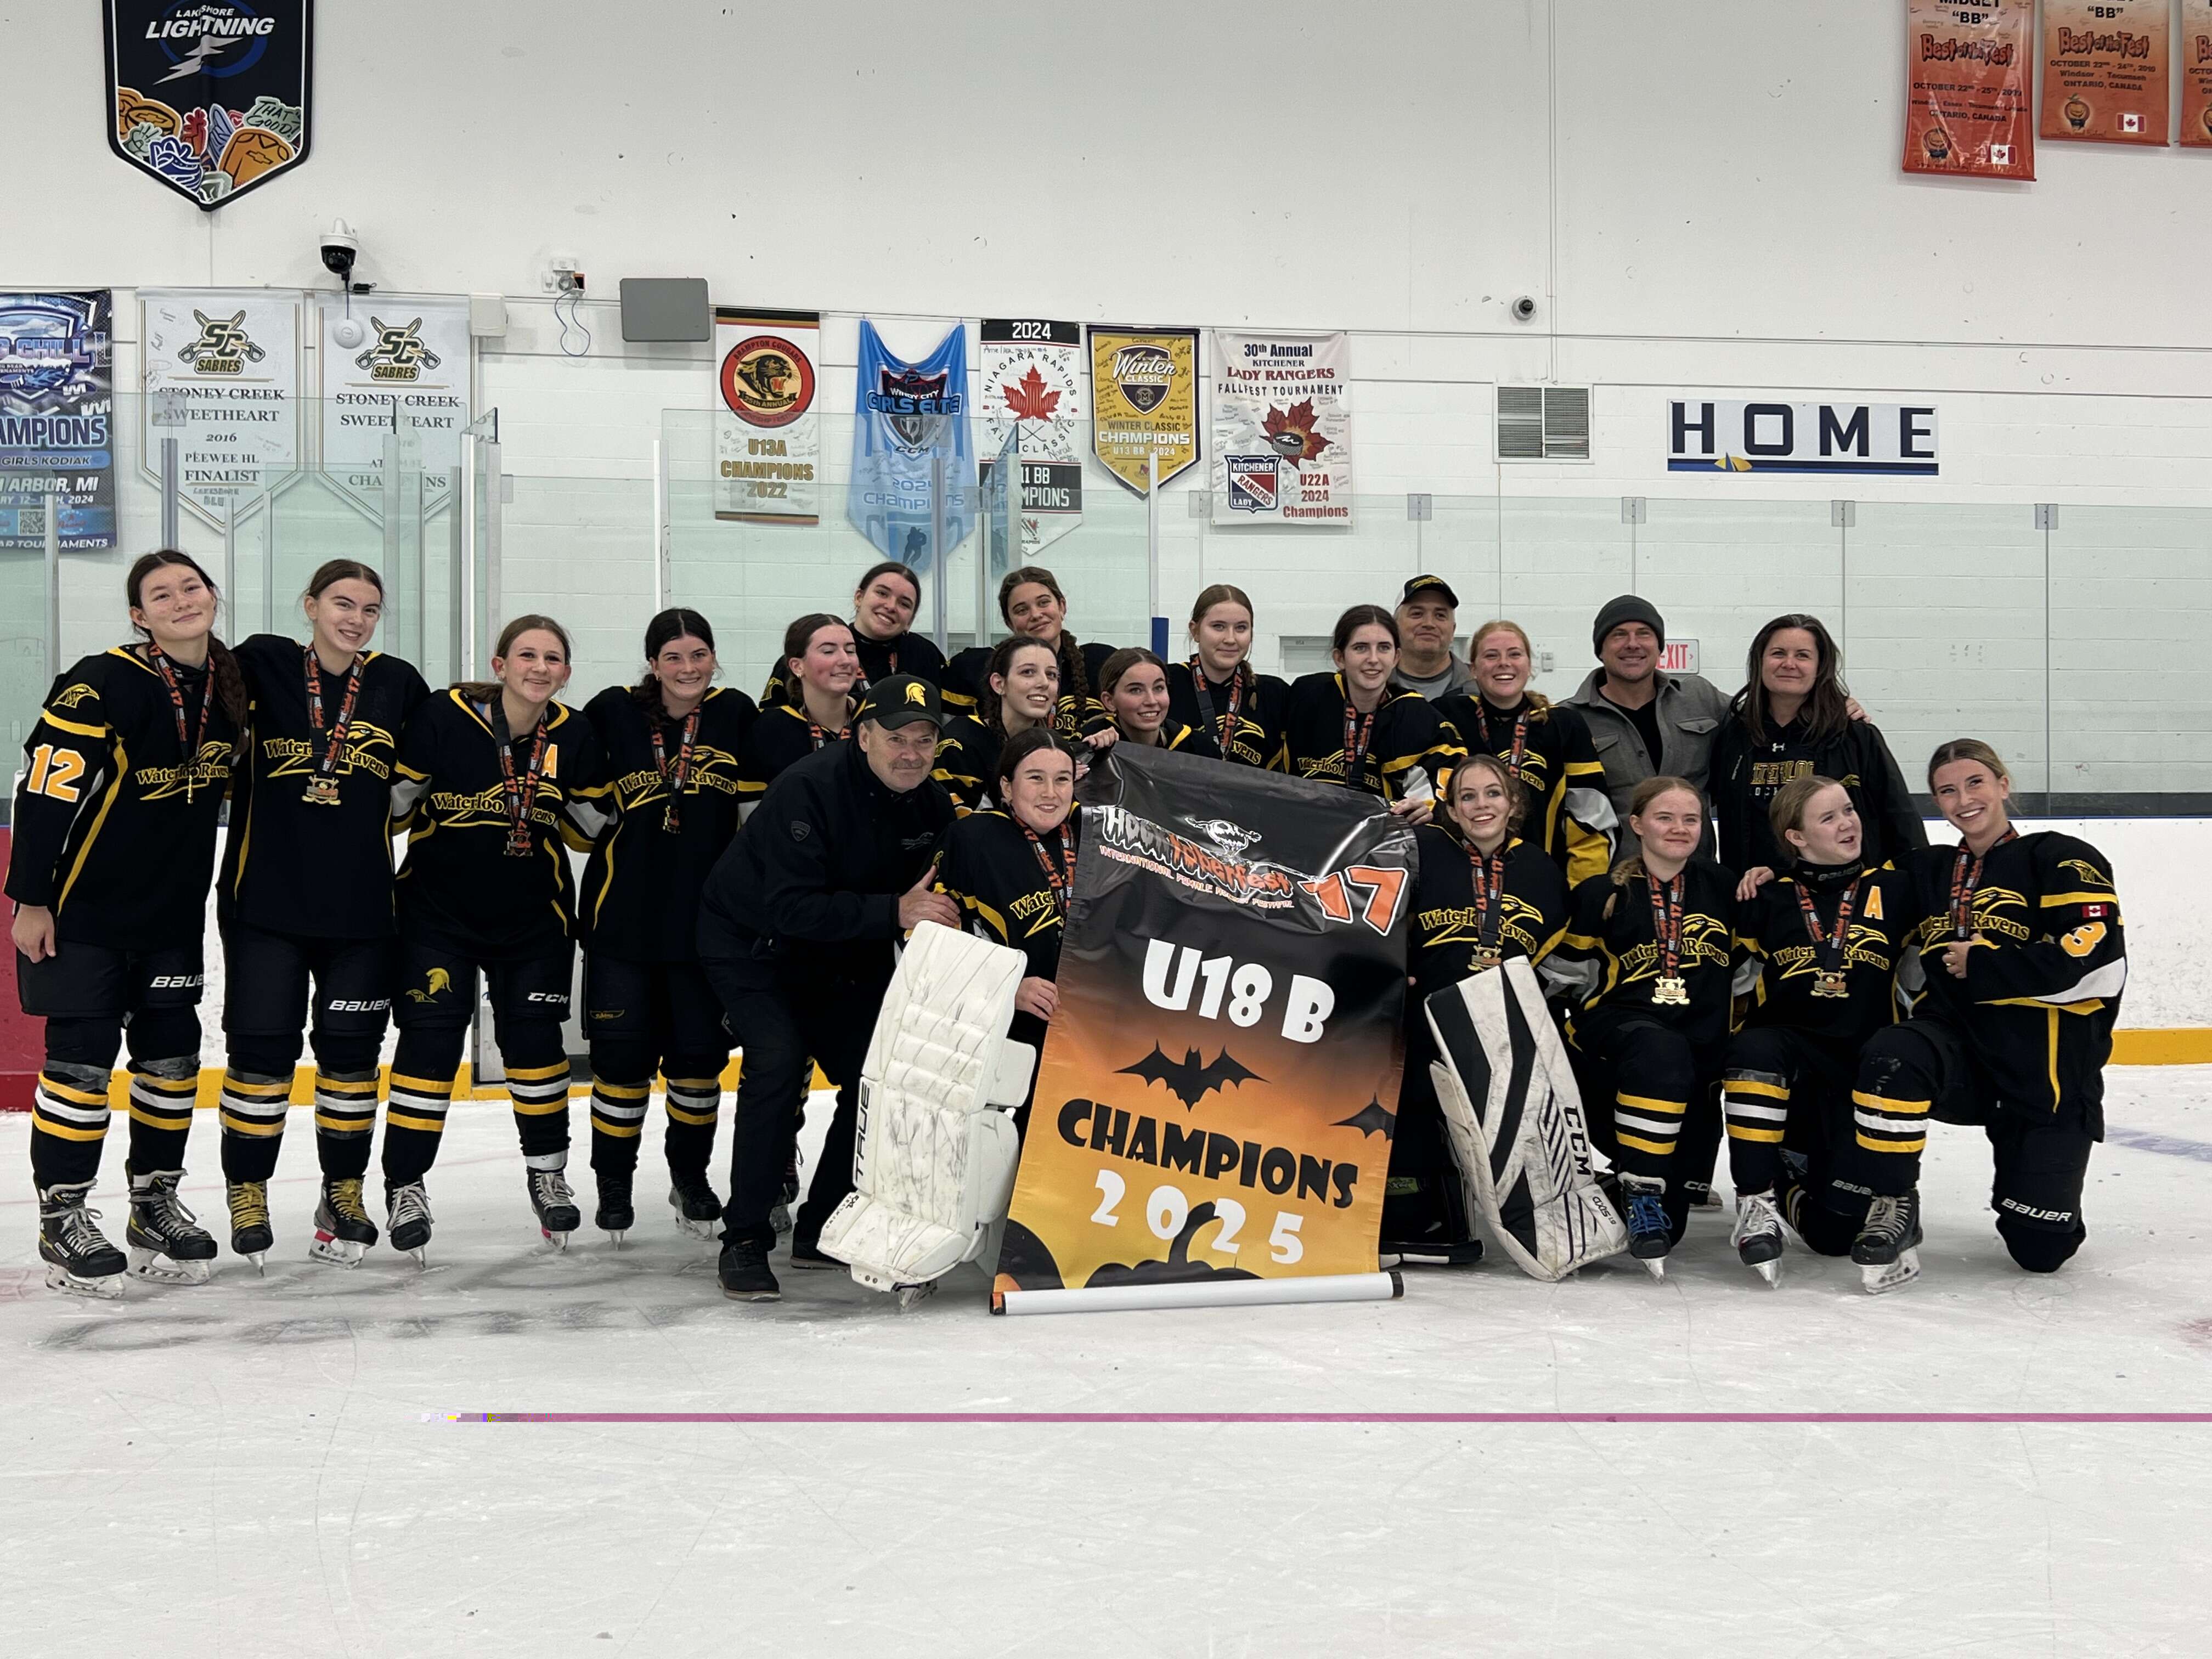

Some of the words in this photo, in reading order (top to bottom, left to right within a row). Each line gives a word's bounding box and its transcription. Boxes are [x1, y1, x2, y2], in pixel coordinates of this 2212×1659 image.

[145, 17, 274, 39] LIGHTNING
[1921, 34, 1957, 62] Best
[2058, 27, 2094, 55] Best
[2117, 31, 2150, 59] Fest
[1914, 82, 1955, 91] OCTOBER
[2108, 82, 2143, 91] CANADA
[247, 115, 298, 138] GOOD!
[1012, 322, 1052, 340] 2024
[16, 338, 90, 363] CHILL
[1244, 344, 1267, 357] 30th
[1270, 343, 1313, 357] Annual
[197, 359, 241, 373] SABRES
[374, 366, 417, 379] SABRES
[1109, 350, 1177, 380] Winter
[1228, 366, 1261, 381] LADY
[1266, 367, 1335, 381] RANGERS
[984, 351, 1034, 393] NIAGARA
[1042, 353, 1077, 397] RAPIDS
[1125, 375, 1164, 383] CLASSIC
[159, 387, 225, 399] STONEY
[229, 388, 285, 400] CREEK
[921, 389, 940, 400] CITY
[1218, 383, 1267, 396] FALLFEST
[1273, 385, 1344, 396] TOURNAMENT
[336, 393, 401, 405] STONEY
[405, 395, 460, 408] CREEK
[761, 398, 791, 407] ANNUAL
[867, 391, 915, 414] GIRLS
[163, 409, 280, 422] SWEETHEART
[340, 415, 455, 428] SWEETEART
[0, 418, 105, 445] MPIONS
[986, 417, 1005, 442] FAL
[1022, 419, 1075, 453] CLASSIC
[1108, 421, 1142, 431] WINTER
[1144, 421, 1181, 432] CLASSIC
[1672, 402, 1934, 458] HOME
[206, 433, 238, 442] 2016
[1098, 431, 1190, 445] CHAMPIONS
[748, 438, 788, 456] U13A
[894, 445, 930, 454] CCM
[1113, 447, 1130, 455] U13
[1133, 447, 1145, 455] BB
[1153, 447, 1176, 456] 2024
[2, 456, 39, 465] GIRLS
[41, 456, 92, 465] KODIAK
[185, 454, 238, 464] PEEWEE
[242, 454, 259, 464] HL
[1232, 462, 1274, 472] KITCHENER
[184, 470, 260, 482] FINALIST
[720, 460, 814, 481] CHAMPIONS
[1022, 466, 1030, 483] 11
[1034, 467, 1050, 484] BB
[8, 477, 70, 493] ARBOR,
[76, 477, 99, 492] MI
[348, 475, 446, 488] CHANS
[1300, 473, 1330, 487] U22A
[747, 482, 788, 499] 2022
[1022, 487, 1070, 507] MPIONS
[1237, 474, 1274, 506] RANGERS
[1301, 489, 1329, 503] 2024
[68, 495, 94, 504] 2024
[864, 492, 964, 510] CHAMPINS
[1233, 498, 1252, 507] LADY
[1283, 506, 1348, 519] Champions
[16, 539, 109, 549] TOUAMENTS
[263, 738, 313, 759] Water
[340, 743, 389, 780] Ravens
[541, 743, 557, 778] A
[1233, 741, 1262, 765] vens
[27, 743, 86, 803] 12
[687, 766, 737, 794] Ravens
[1520, 769, 1545, 791] vens
[431, 792, 504, 812] Waterloo
[532, 807, 556, 825] vens
[1297, 865, 1408, 937] 17
[1863, 885, 1884, 921] A
[1418, 907, 1477, 930] Waterlo
[1498, 916, 1537, 955] Ravens
[1970, 911, 2030, 940] Ravens
[1773, 946, 1817, 966] Water
[1842, 944, 1890, 970] Ravens
[149, 974, 203, 988] BAUE
[527, 992, 569, 1004] CCM
[1142, 938, 1273, 1028] U18
[1282, 974, 1335, 1044] B
[855, 1084, 871, 1184] TRUE
[1563, 1105, 1592, 1176] CCM
[1057, 1098, 1358, 1209] CHAMPIONS
[1683, 1180, 1710, 1193] CC
[1832, 1180, 1872, 1196] BAUE
[1090, 1169, 1305, 1265] 2025
